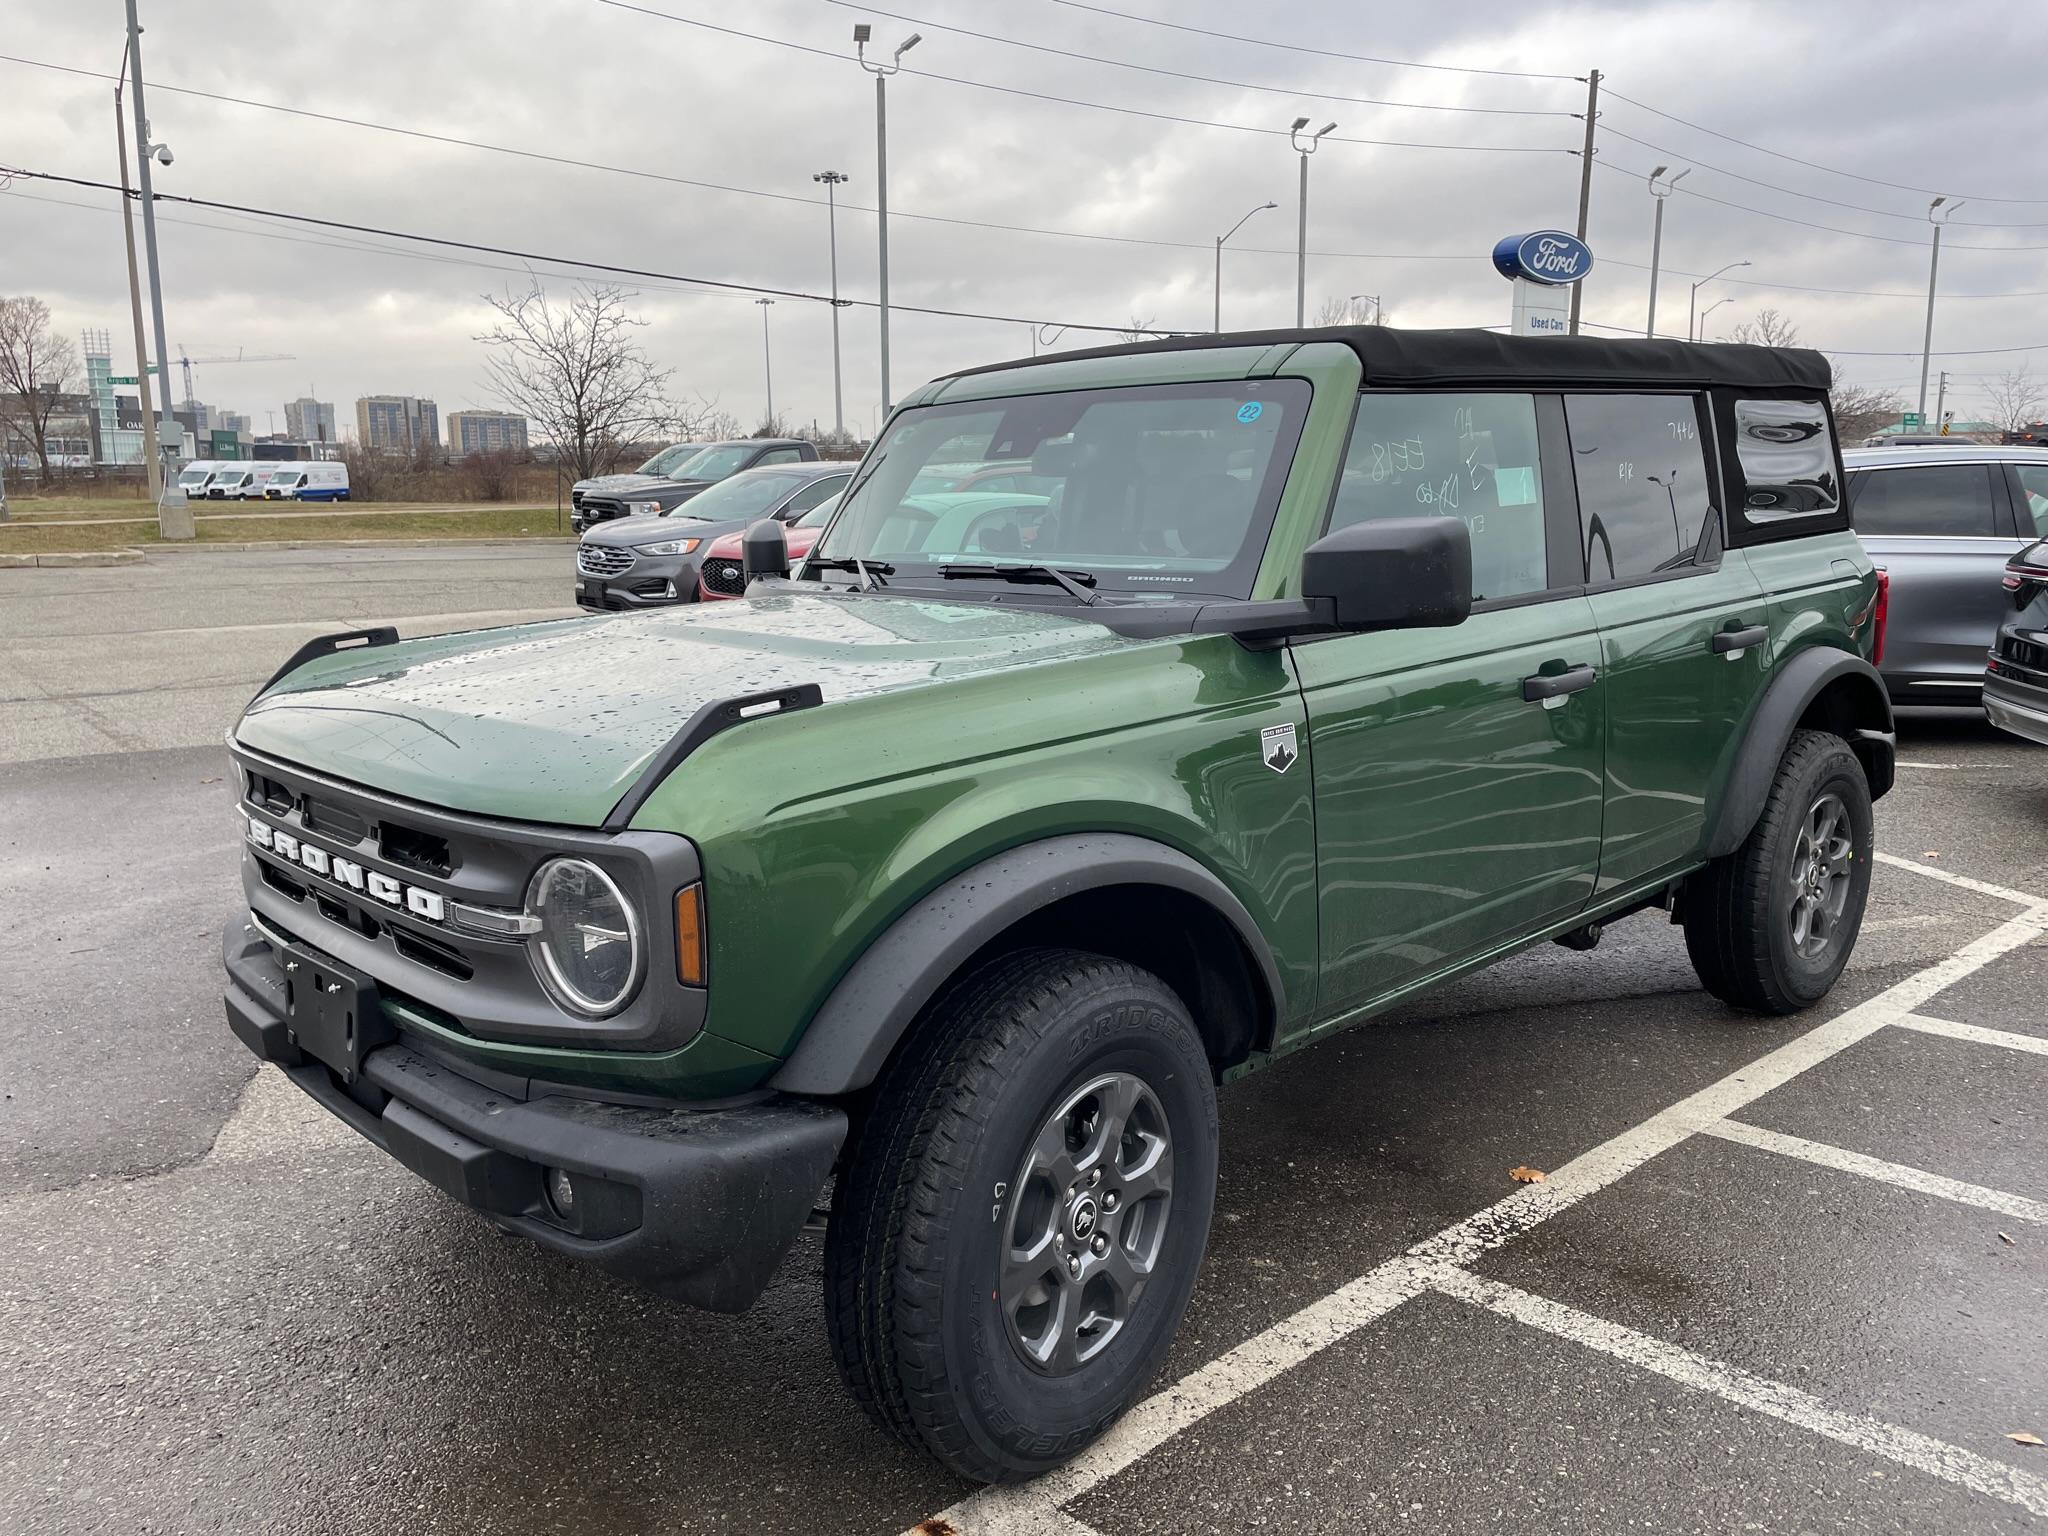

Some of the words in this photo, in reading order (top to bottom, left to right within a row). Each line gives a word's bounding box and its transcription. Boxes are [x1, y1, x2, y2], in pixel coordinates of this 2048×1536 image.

[1533, 238, 1579, 274] Ford
[1531, 317, 1549, 329] Used
[1550, 318, 1564, 331] Cars
[1239, 405, 1259, 419] 22
[250, 817, 446, 921] BRONCO
